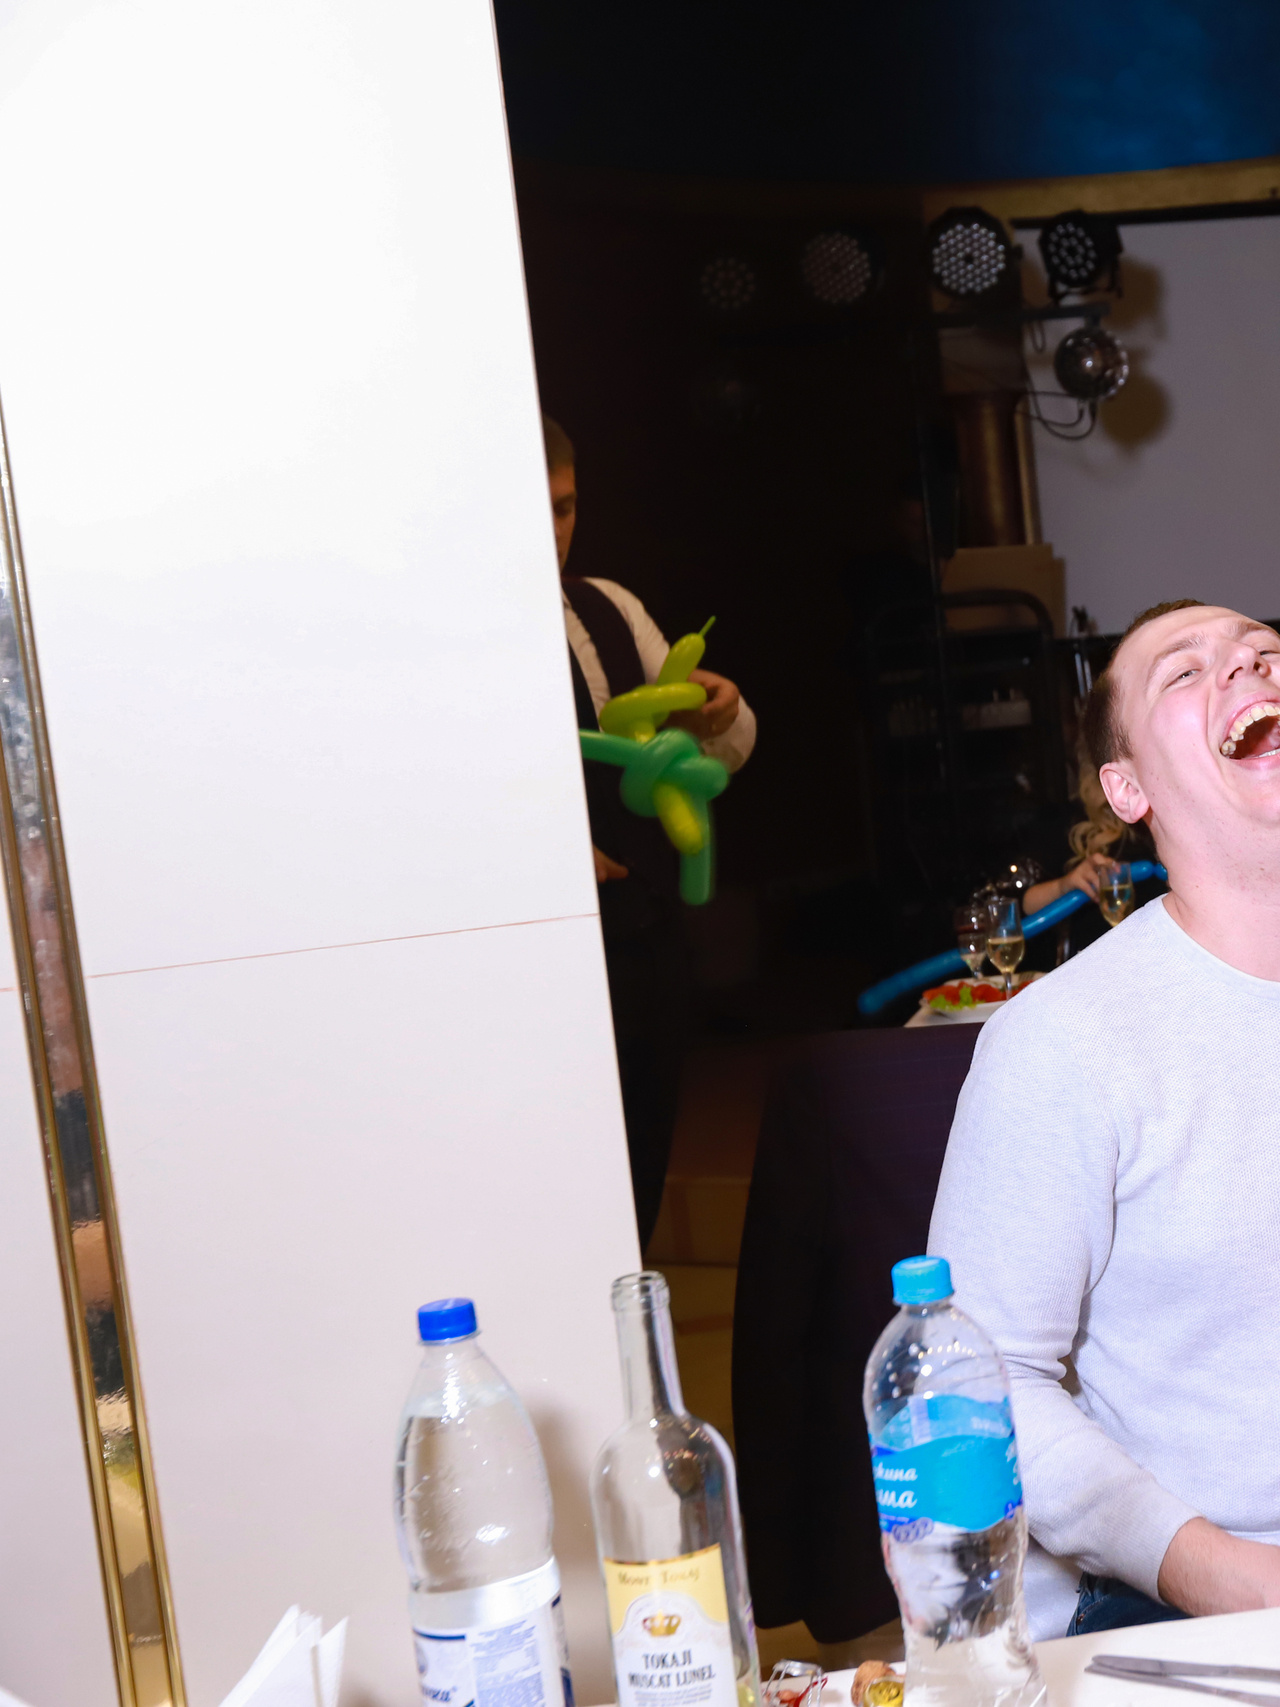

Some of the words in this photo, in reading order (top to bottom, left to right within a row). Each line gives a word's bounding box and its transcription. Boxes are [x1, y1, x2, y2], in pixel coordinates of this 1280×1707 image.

[642, 1648, 692, 1669] TOKAJI
[627, 1671, 672, 1688] MUSCAT
[675, 1662, 717, 1687] LUNEL
